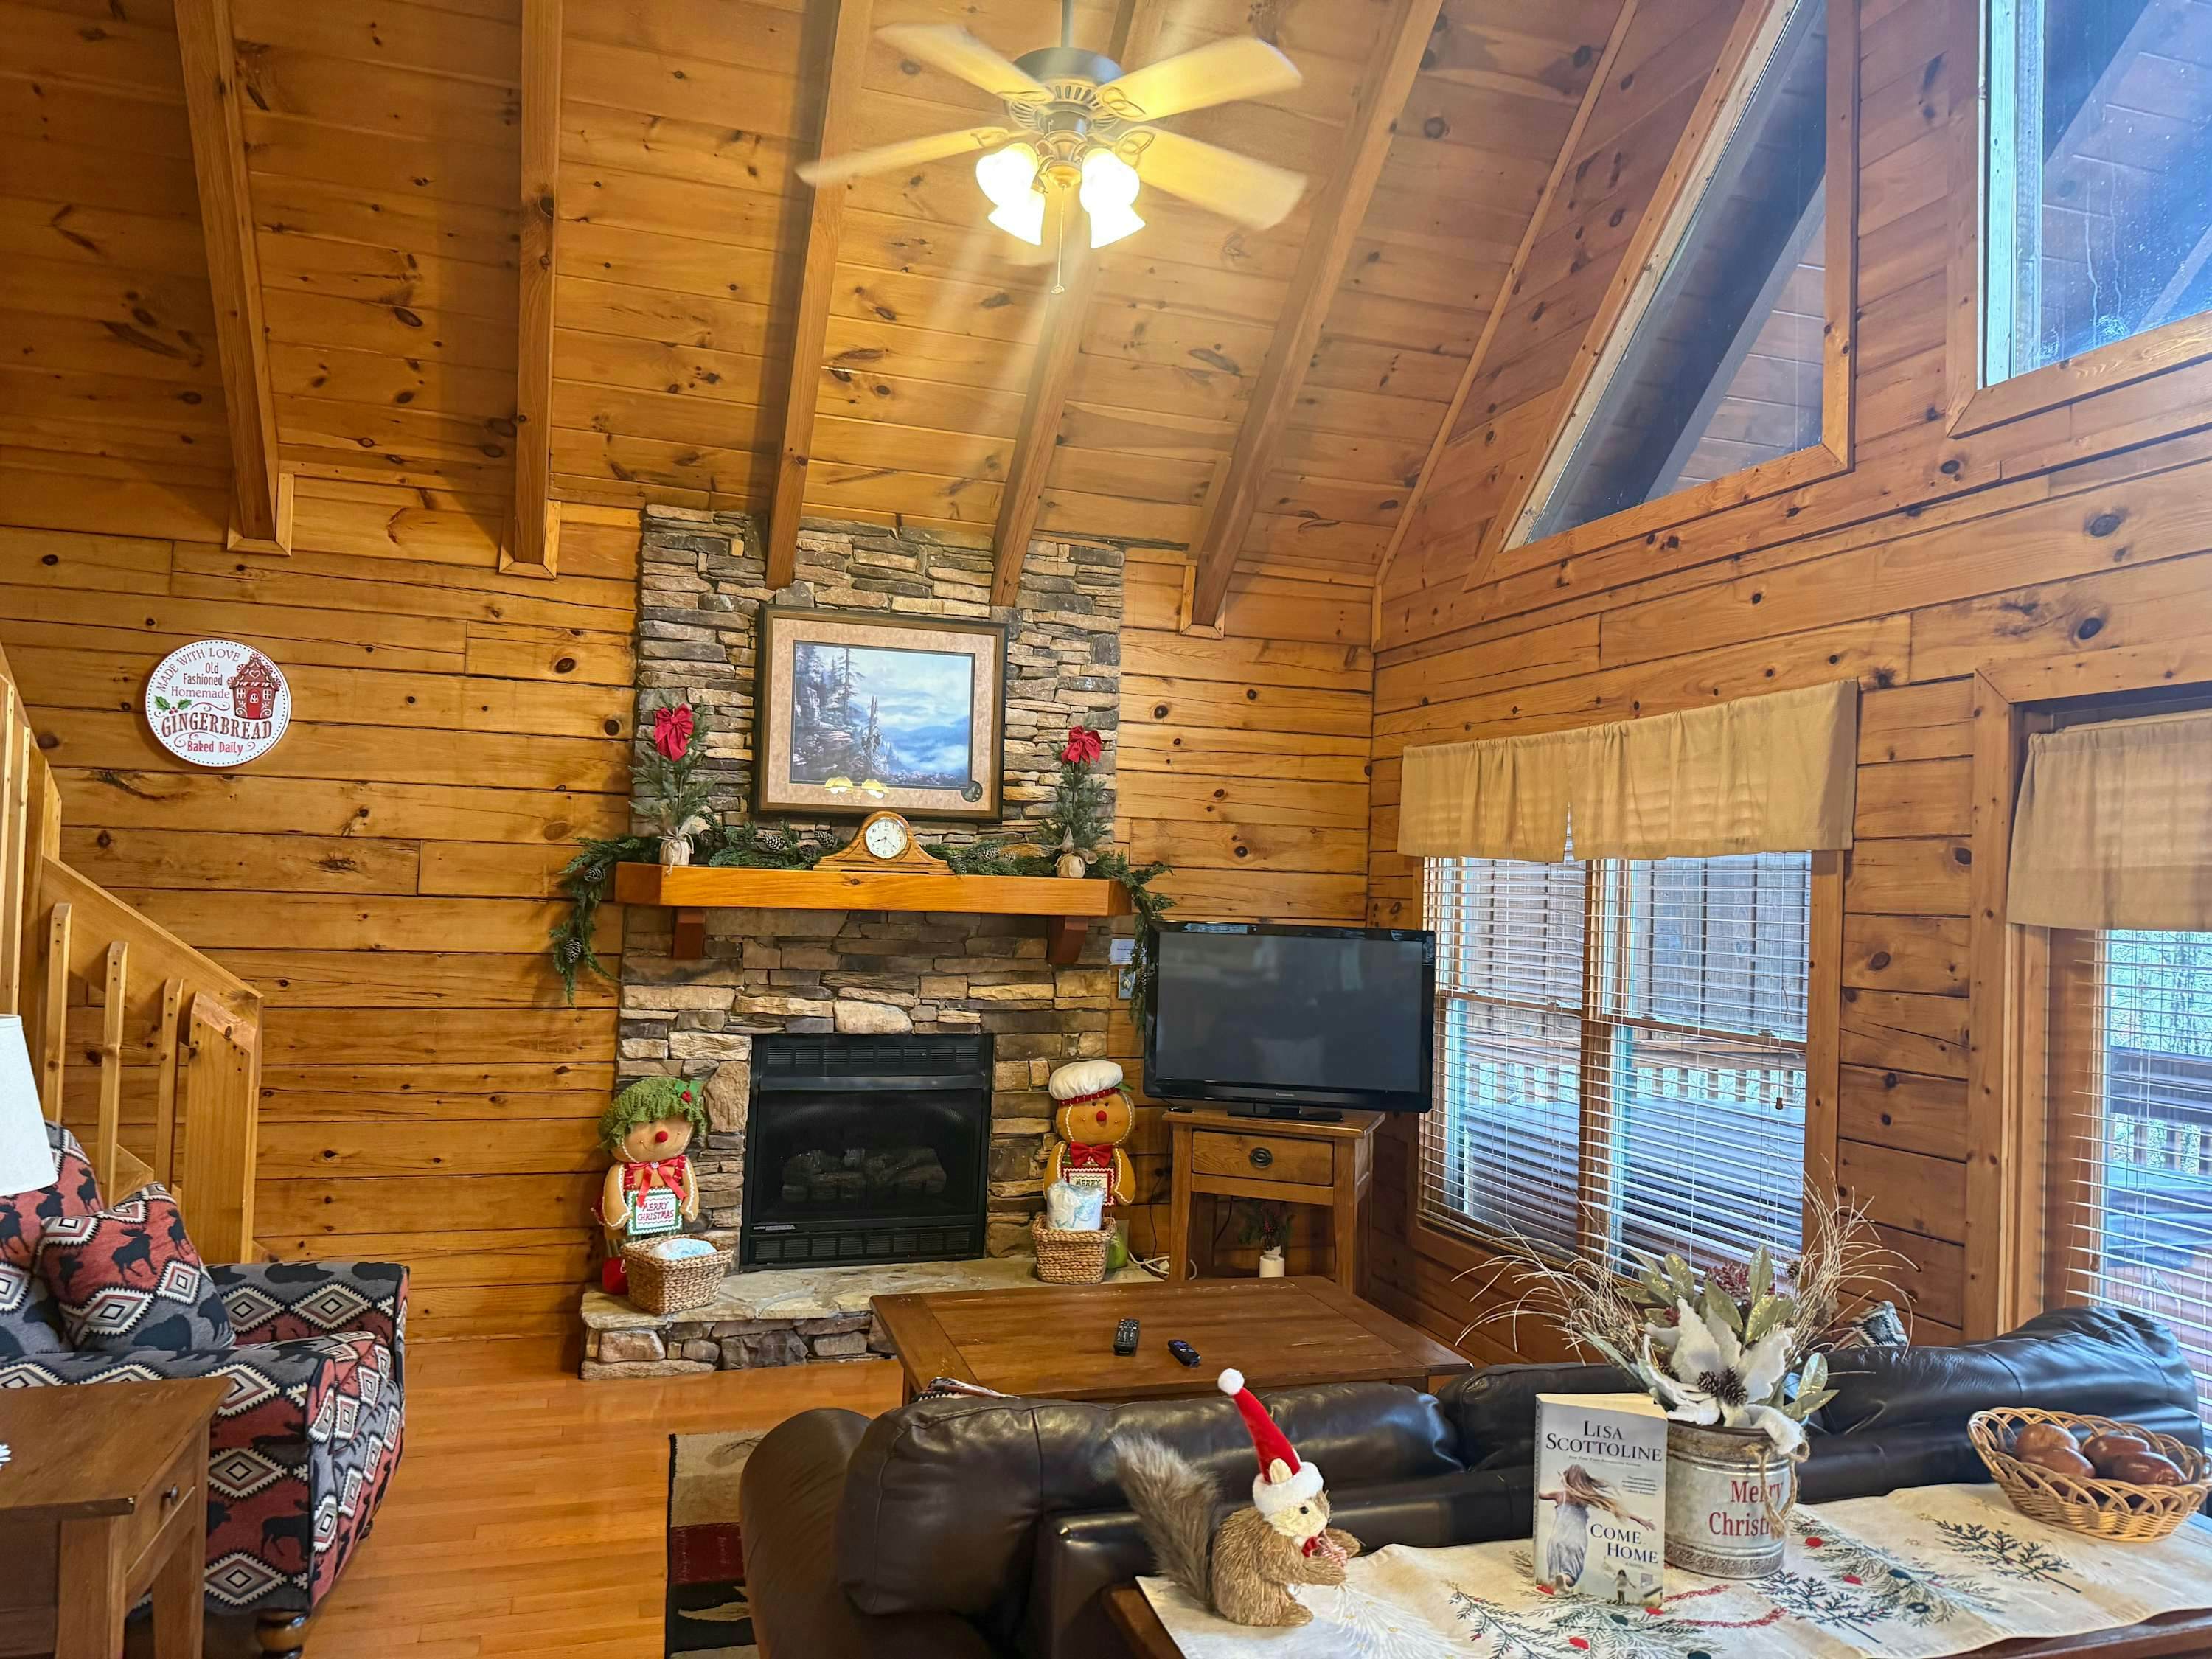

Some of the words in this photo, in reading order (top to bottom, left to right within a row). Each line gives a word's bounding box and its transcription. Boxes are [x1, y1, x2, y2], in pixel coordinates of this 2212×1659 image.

[156, 664, 179, 692] MADE
[177, 649, 205, 666] WITH
[209, 648, 241, 662] LOVE
[205, 662, 219, 674] Old
[183, 673, 223, 686] Fashioned
[171, 686, 230, 699] Homemade
[161, 712, 272, 740] GINGERBREAD
[187, 741, 214, 752] Baked
[219, 742, 243, 755] Daily
[1076, 1179, 1102, 1187] MERRY
[637, 1210, 675, 1221] CHRISTMAS
[1584, 1420, 1624, 1440] LISA
[1545, 1433, 1663, 1462] SCOTTOLINE
[1590, 1523, 1642, 1545] COME
[1709, 1512, 1770, 1536] Christ
[1607, 1542, 1658, 1564] HOME
